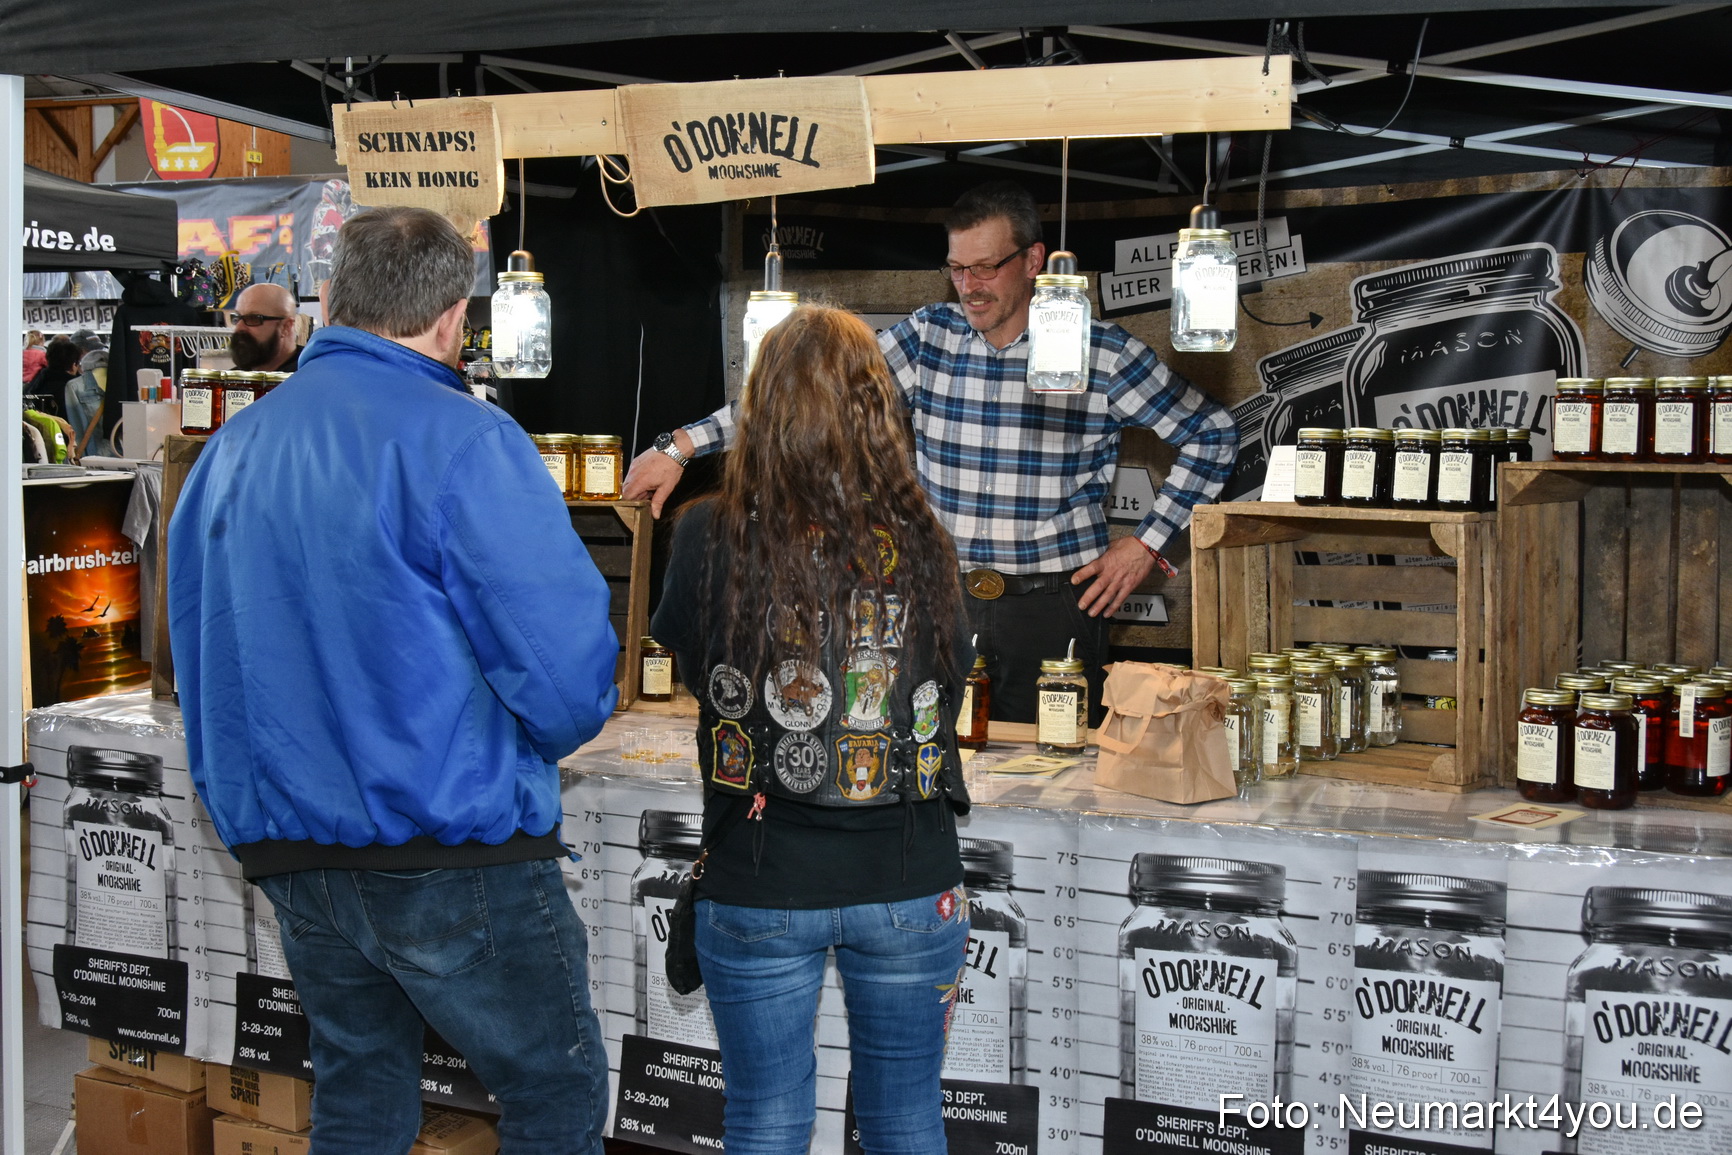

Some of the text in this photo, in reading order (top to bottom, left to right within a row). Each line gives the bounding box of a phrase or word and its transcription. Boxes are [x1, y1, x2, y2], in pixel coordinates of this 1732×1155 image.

[358, 131, 476, 152] SCHNAPS!
[664, 112, 820, 173] O'DONNELL
[366, 171, 479, 188] KEIN HONIG
[708, 163, 782, 180] MOONSHINE
[1111, 277, 1161, 300] HIER
[778, 734, 798, 755] WHEELS
[800, 733, 808, 741] OF
[788, 746, 815, 767] 30
[778, 768, 823, 790] ANNIVERSARY
[792, 767, 811, 775] YEARS
[86, 798, 144, 816] MASON
[80, 828, 156, 871] O'DONNELL
[105, 861, 133, 873] ORIGINAL
[97, 873, 142, 892] MOONSHINE
[80, 890, 92, 900] 38%
[107, 895, 115, 904] 76
[140, 900, 151, 908] 700
[1155, 919, 1255, 942] MASON
[1369, 936, 1476, 962] MASON
[88, 957, 151, 977] SHERIFF'S DEPT.
[1610, 956, 1723, 980] MASON
[73, 970, 166, 992] O'DONNELL MOONSHINE
[651, 976, 666, 987] 38%
[1142, 958, 1263, 1010] O'DONNELL
[61, 991, 96, 1006] 3-29-2014
[258, 998, 304, 1015] O'DONNELL
[1182, 997, 1226, 1014] ORIGINAL
[1355, 977, 1486, 1034] O'DONNELL
[65, 1012, 91, 1028] 38% vol.
[157, 1007, 180, 1020] 700ml
[971, 1013, 989, 1023] 700
[241, 1022, 282, 1038] 3-29-2014
[1168, 1012, 1238, 1036] MOONSHINE
[1396, 1019, 1443, 1038] ORIGINAL
[1593, 1000, 1732, 1055] O'DONNELL
[118, 1027, 180, 1045] www.odonnell.de
[239, 1047, 271, 1061] 38% vol.
[1140, 1034, 1262, 1058] 38% vol. 76 proof 700 ml
[1381, 1035, 1455, 1061] MOONSHINE
[1637, 1042, 1688, 1060] ORIGINAL
[422, 1053, 467, 1069] 3-29-2014
[662, 1052, 709, 1071] SHERIFF'S
[646, 1064, 695, 1084] O'DONNELL
[1351, 1057, 1481, 1085] 38% vol. 76 proof 700 ml
[1621, 1059, 1702, 1084] MOONSHINE
[230, 1085, 260, 1106] SPIRIT
[420, 1079, 453, 1095] 38% vol.
[1587, 1082, 1608, 1096] 38%
[1610, 1088, 1628, 1098] vol.
[1637, 1088, 1651, 1100] 76
[1696, 1094, 1717, 1107] 700
[624, 1090, 669, 1108] 3-29-2014
[956, 1091, 987, 1106] DEPT.
[941, 1106, 1008, 1124] MOONSHINE
[620, 1118, 656, 1134] 38% vol.
[1156, 1115, 1250, 1141] SHERIFF'S DEPT.
[1135, 1128, 1199, 1149] O'DONNELL
[995, 1142, 1028, 1155] 700ml
